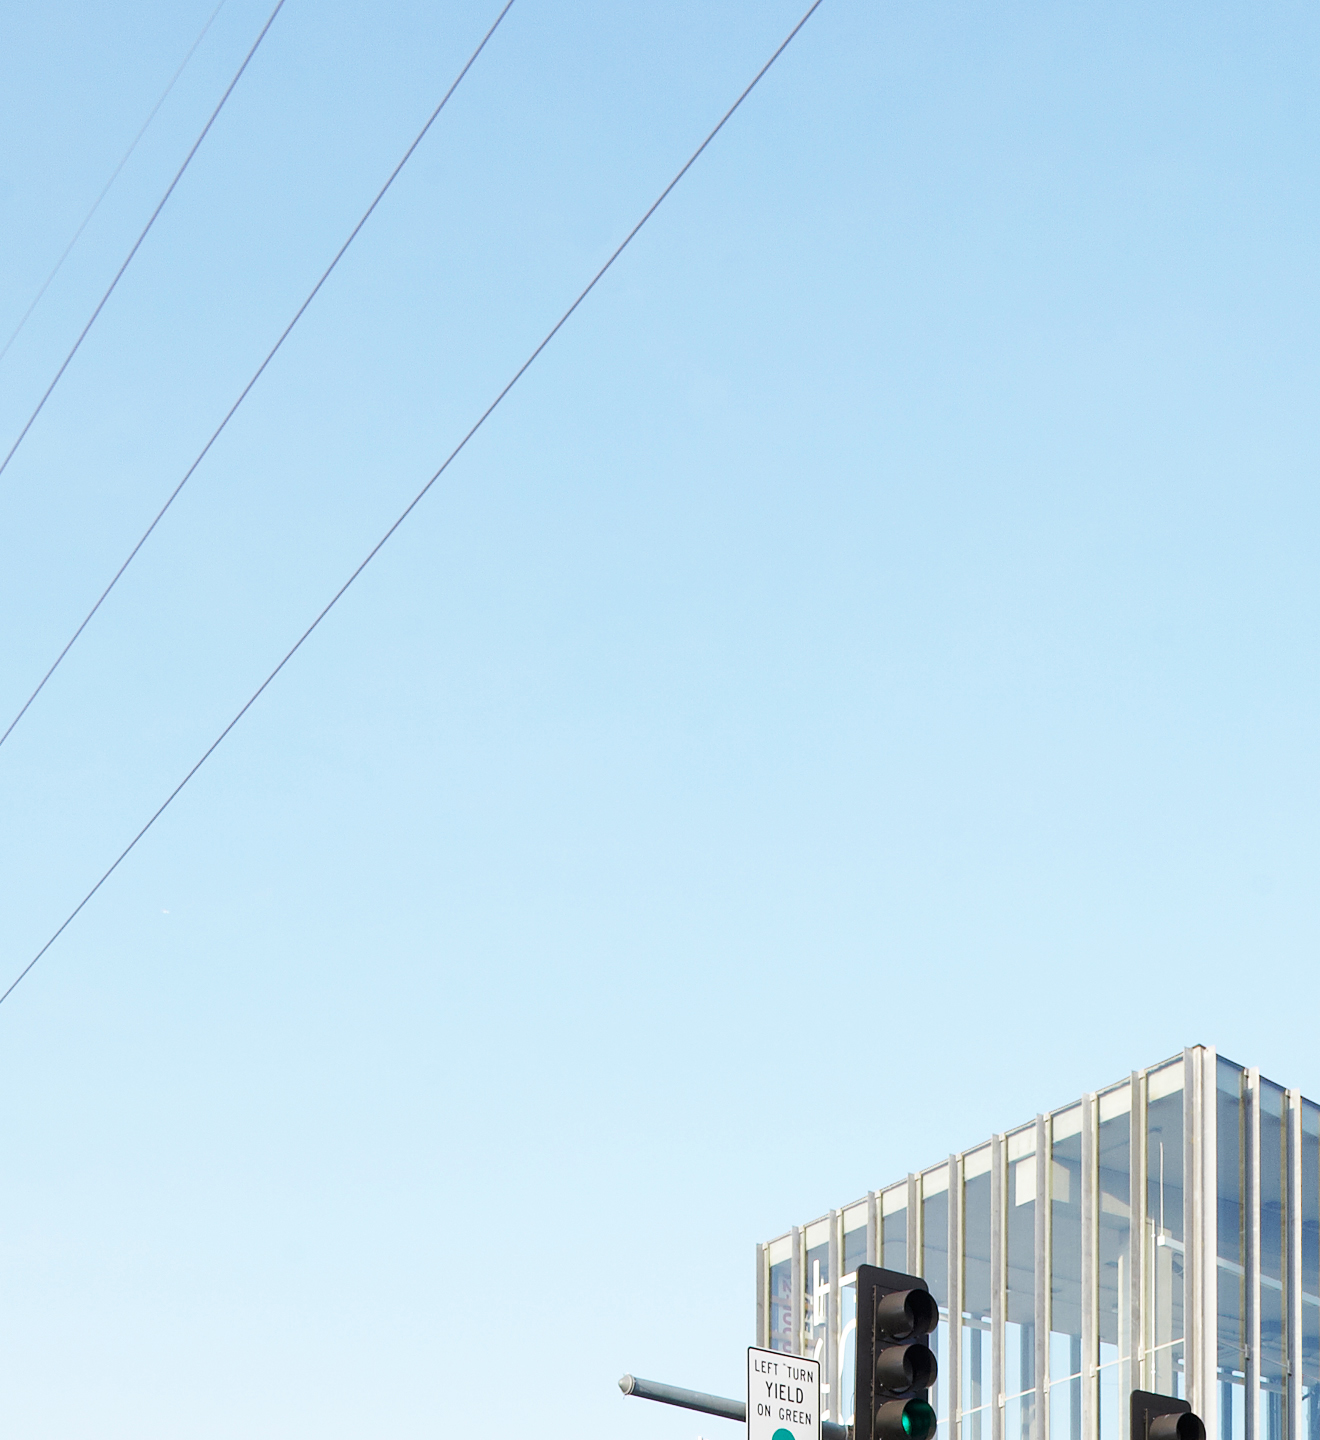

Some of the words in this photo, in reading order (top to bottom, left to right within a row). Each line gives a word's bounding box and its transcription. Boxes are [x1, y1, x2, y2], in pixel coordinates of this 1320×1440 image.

[754, 1359, 778, 1376] LEFT
[787, 1366, 814, 1383] TURN
[765, 1380, 804, 1404] YIELD
[757, 1403, 771, 1417] ON
[778, 1407, 812, 1426] GREEN
